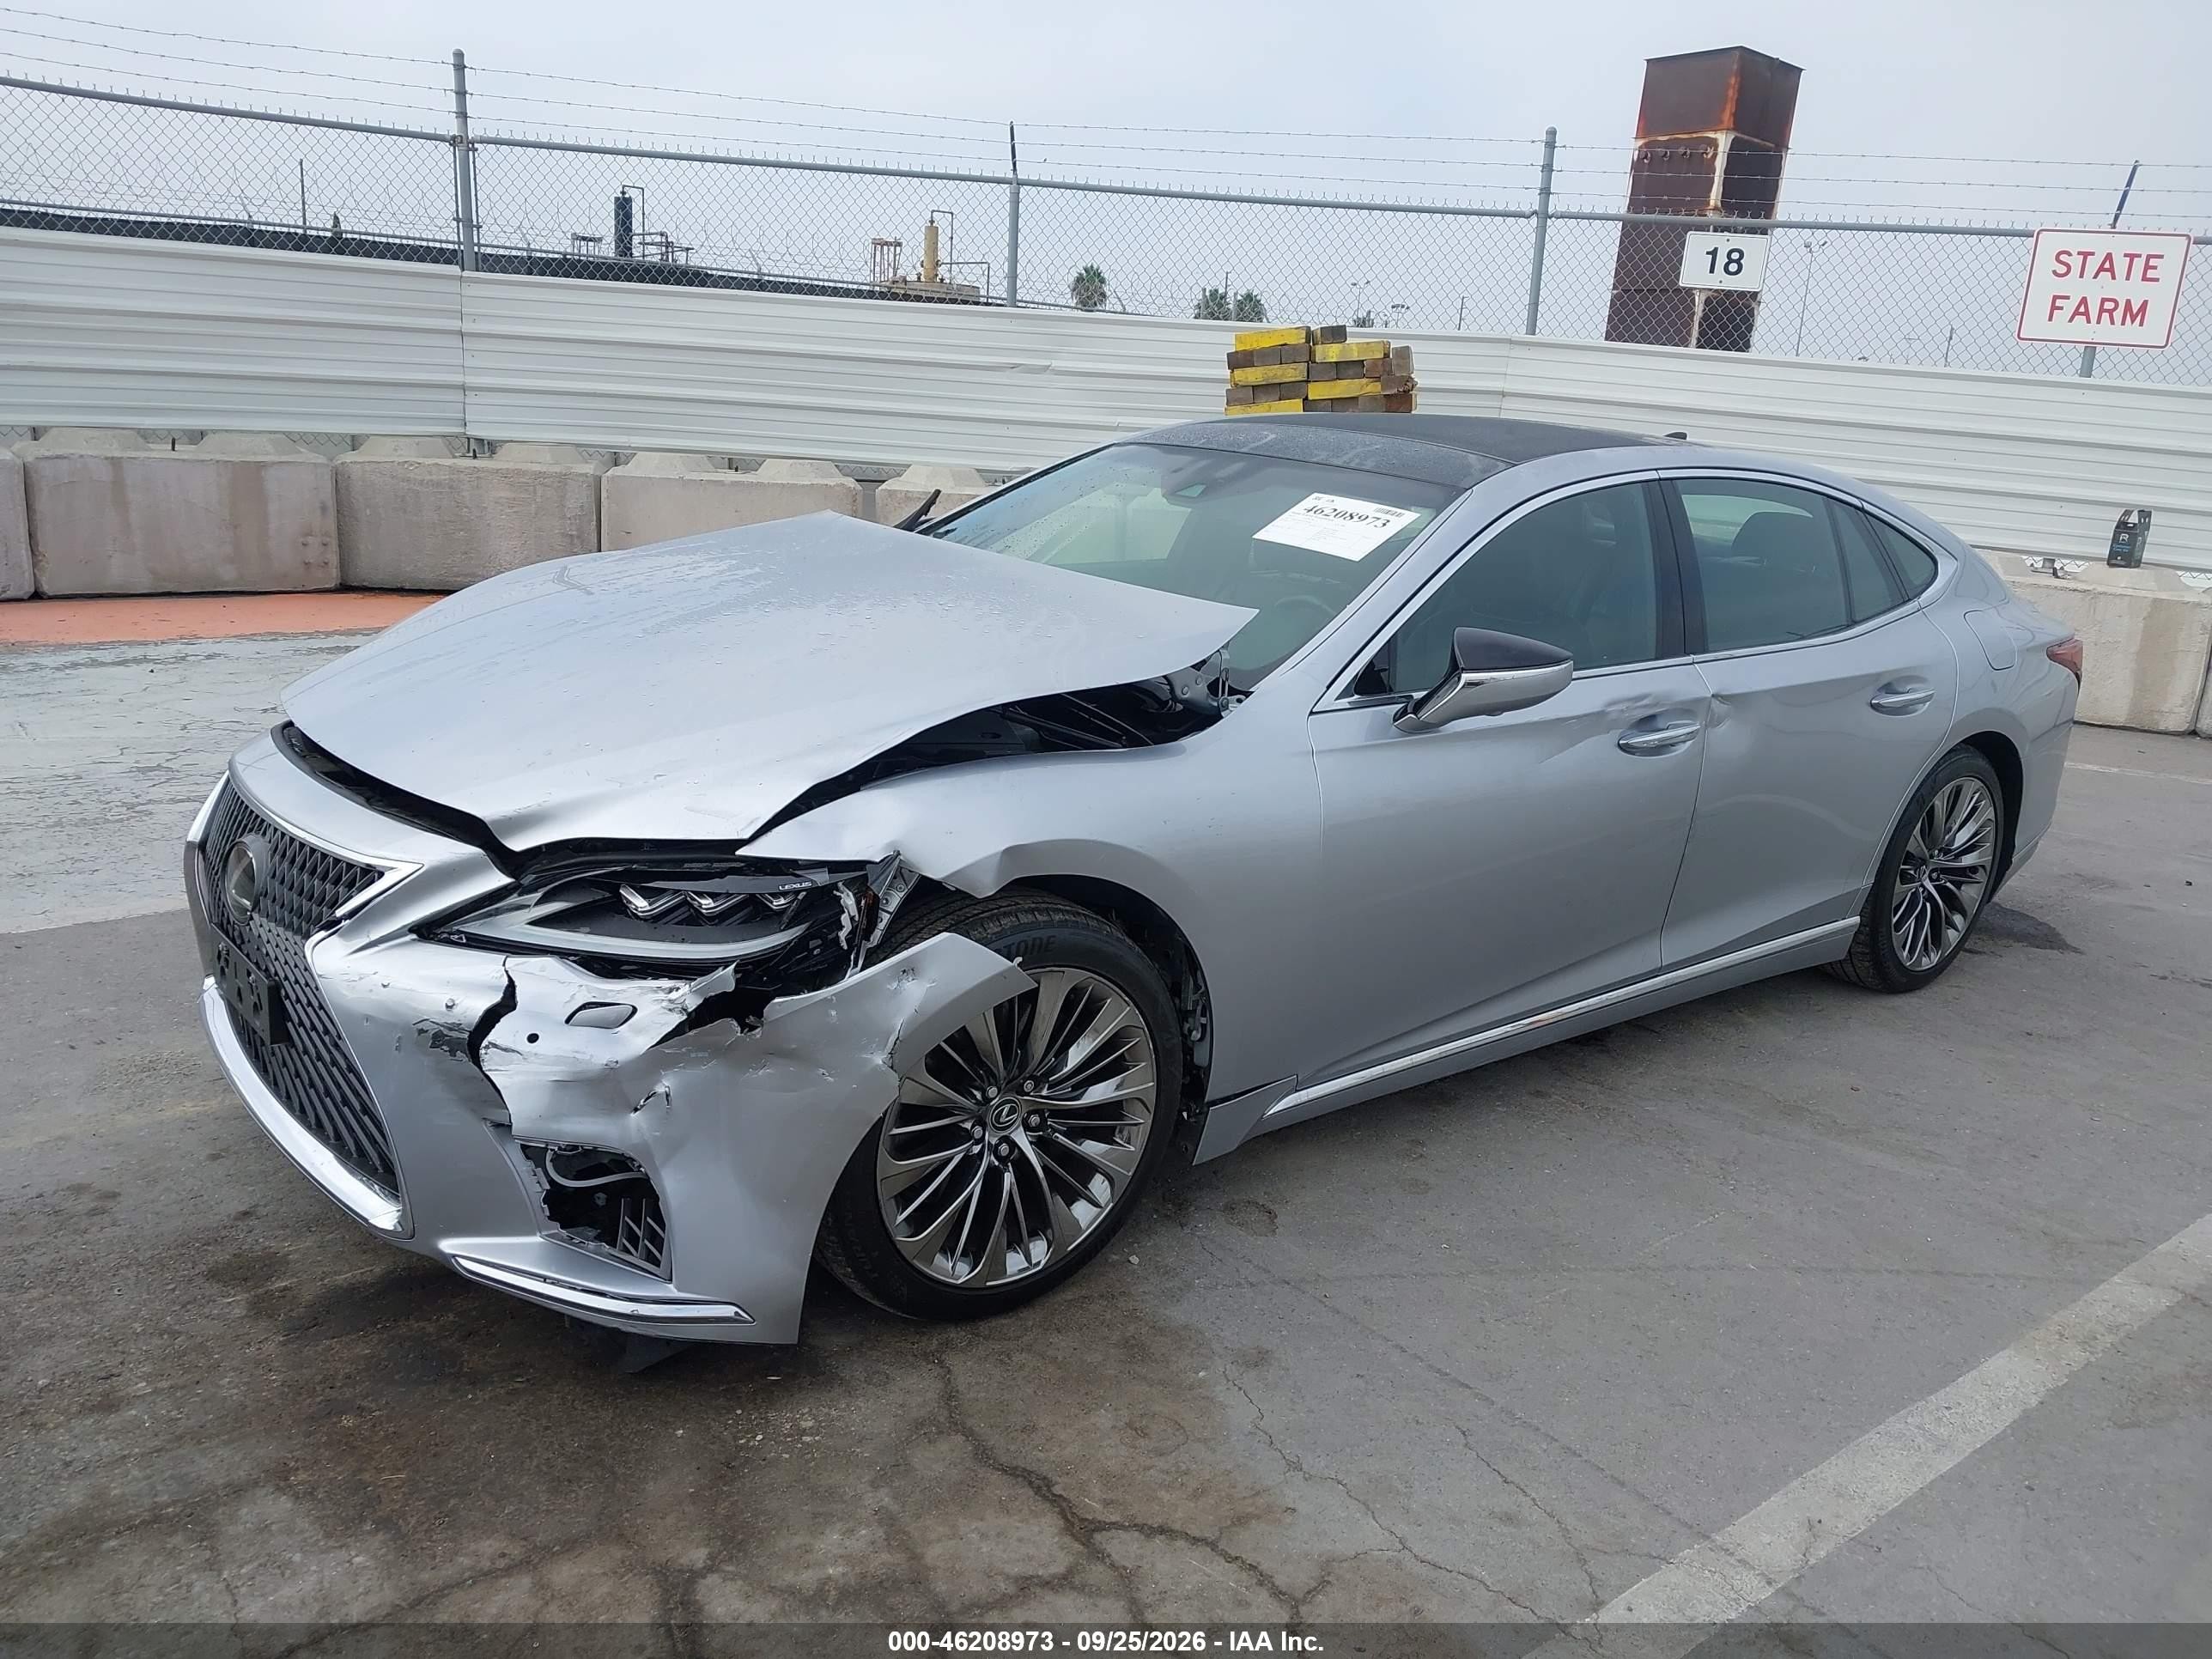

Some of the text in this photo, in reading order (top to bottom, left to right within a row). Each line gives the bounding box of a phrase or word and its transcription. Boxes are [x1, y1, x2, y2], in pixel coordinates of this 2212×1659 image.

[1705, 246, 1745, 276] 18
[2051, 250, 2165, 283] STATE
[2047, 295, 2149, 327] FARM
[1304, 504, 1391, 529] 46208973
[778, 881, 812, 891] LEXUS
